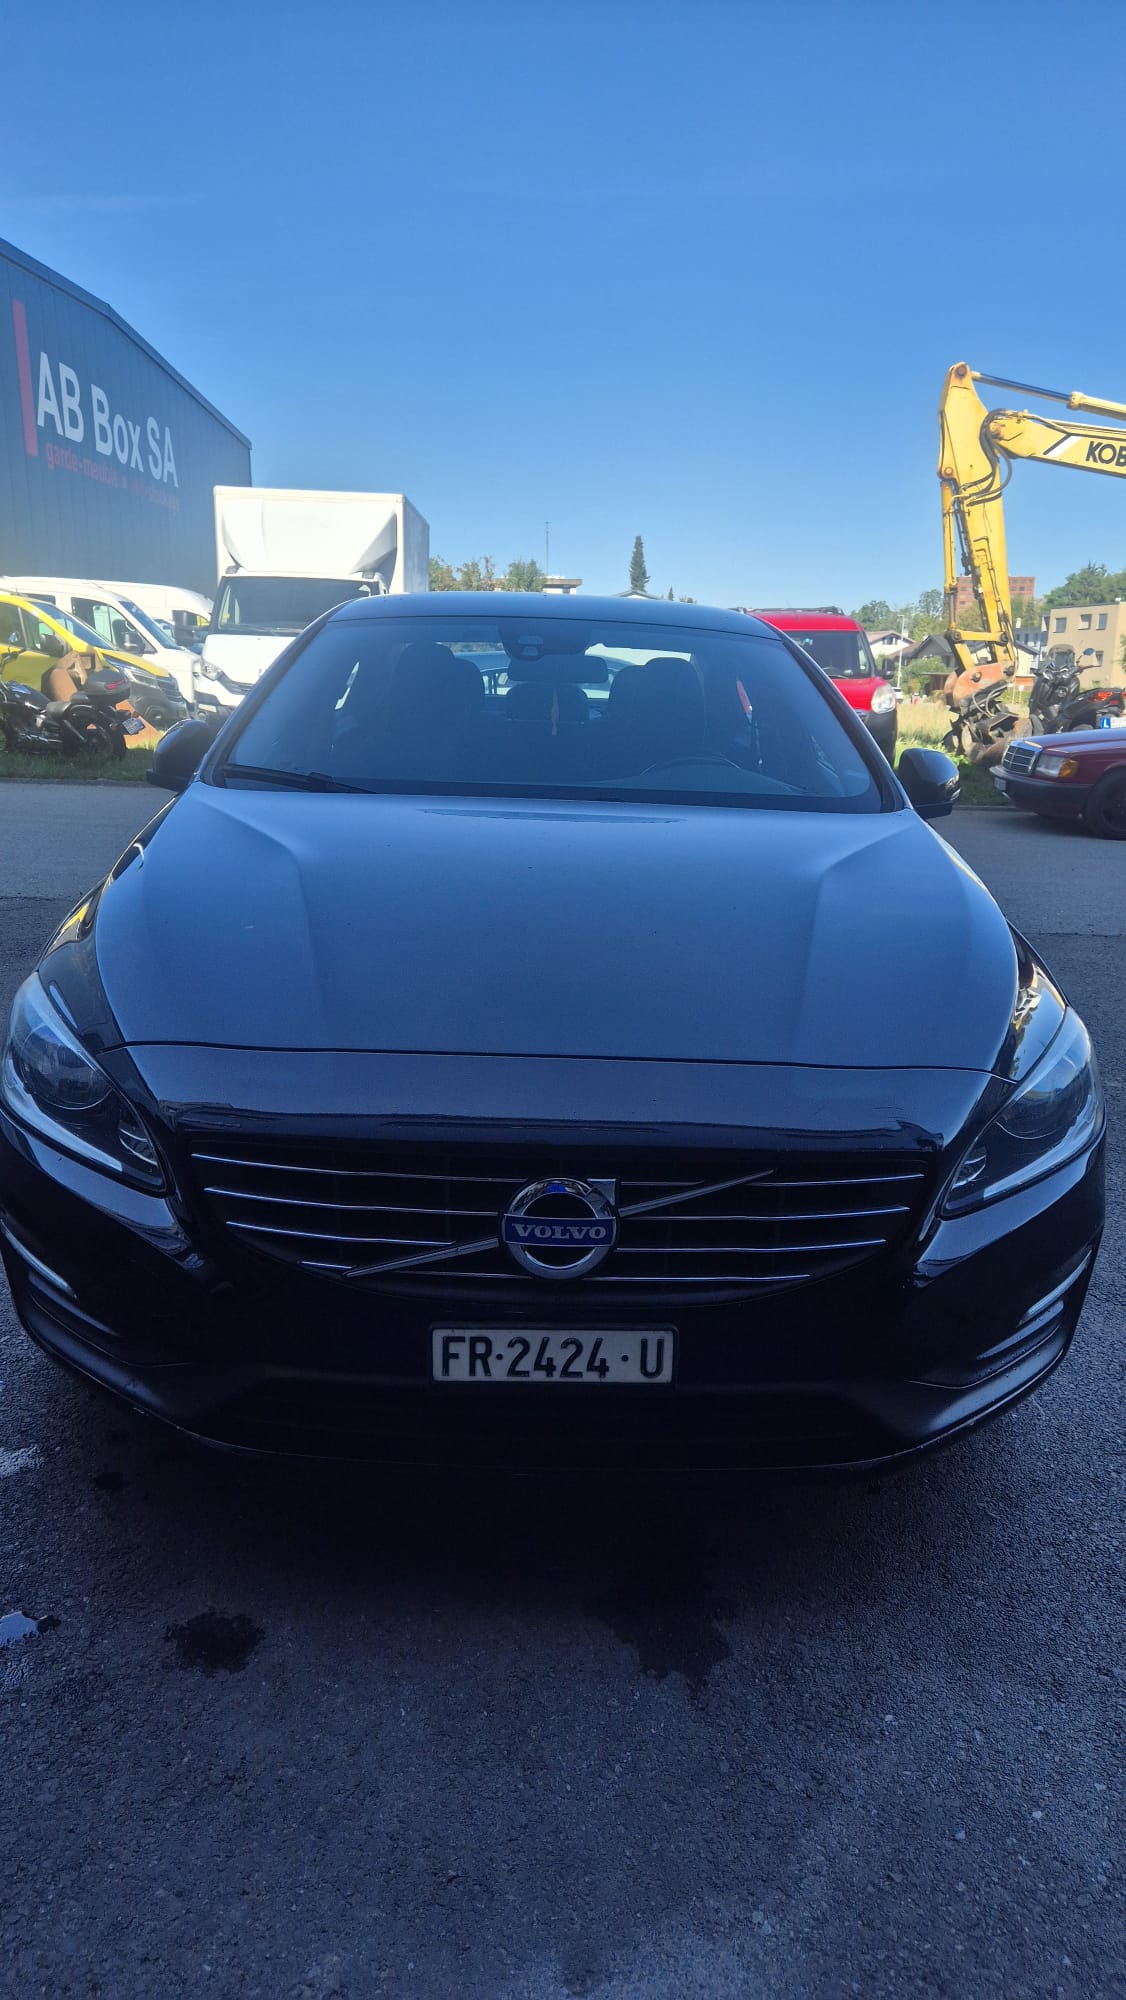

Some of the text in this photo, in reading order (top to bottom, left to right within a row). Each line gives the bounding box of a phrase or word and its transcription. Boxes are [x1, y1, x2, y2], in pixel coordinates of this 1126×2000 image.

[37, 351, 84, 443] AB
[147, 416, 179, 488] SA
[1085, 440, 1126, 467] KOB
[512, 1222, 607, 1240] VOLVO
